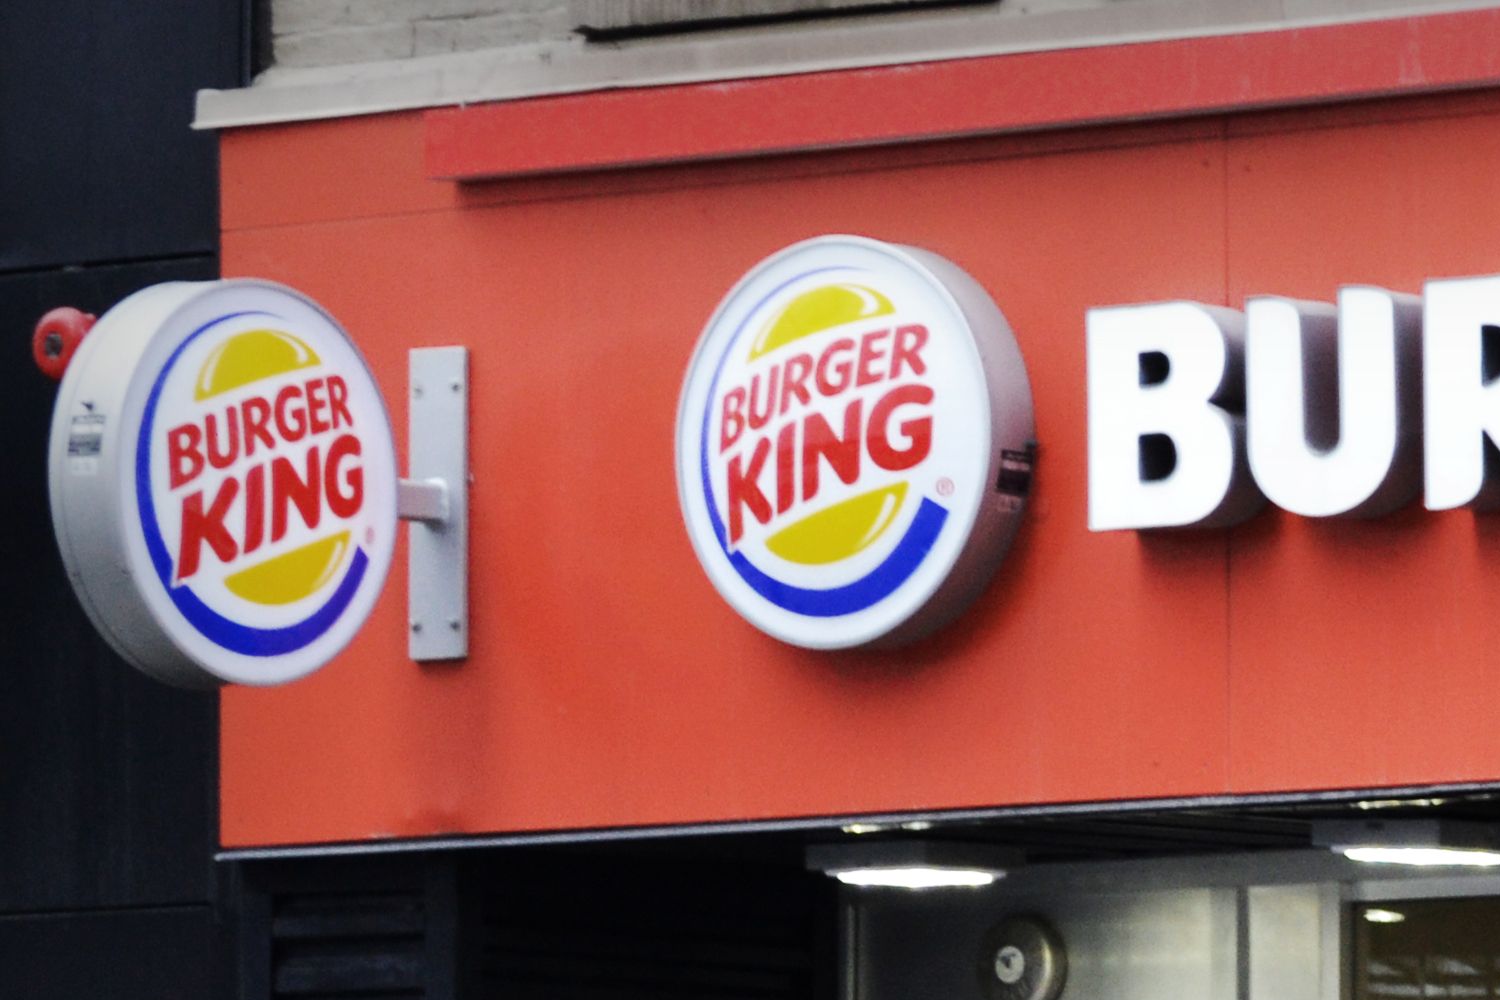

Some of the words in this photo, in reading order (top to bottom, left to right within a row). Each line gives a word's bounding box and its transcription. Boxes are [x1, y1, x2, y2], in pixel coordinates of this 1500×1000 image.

[167, 375, 353, 491] BURGER
[719, 323, 930, 456] BURGER
[175, 433, 364, 584] KING
[726, 383, 935, 546] KING
